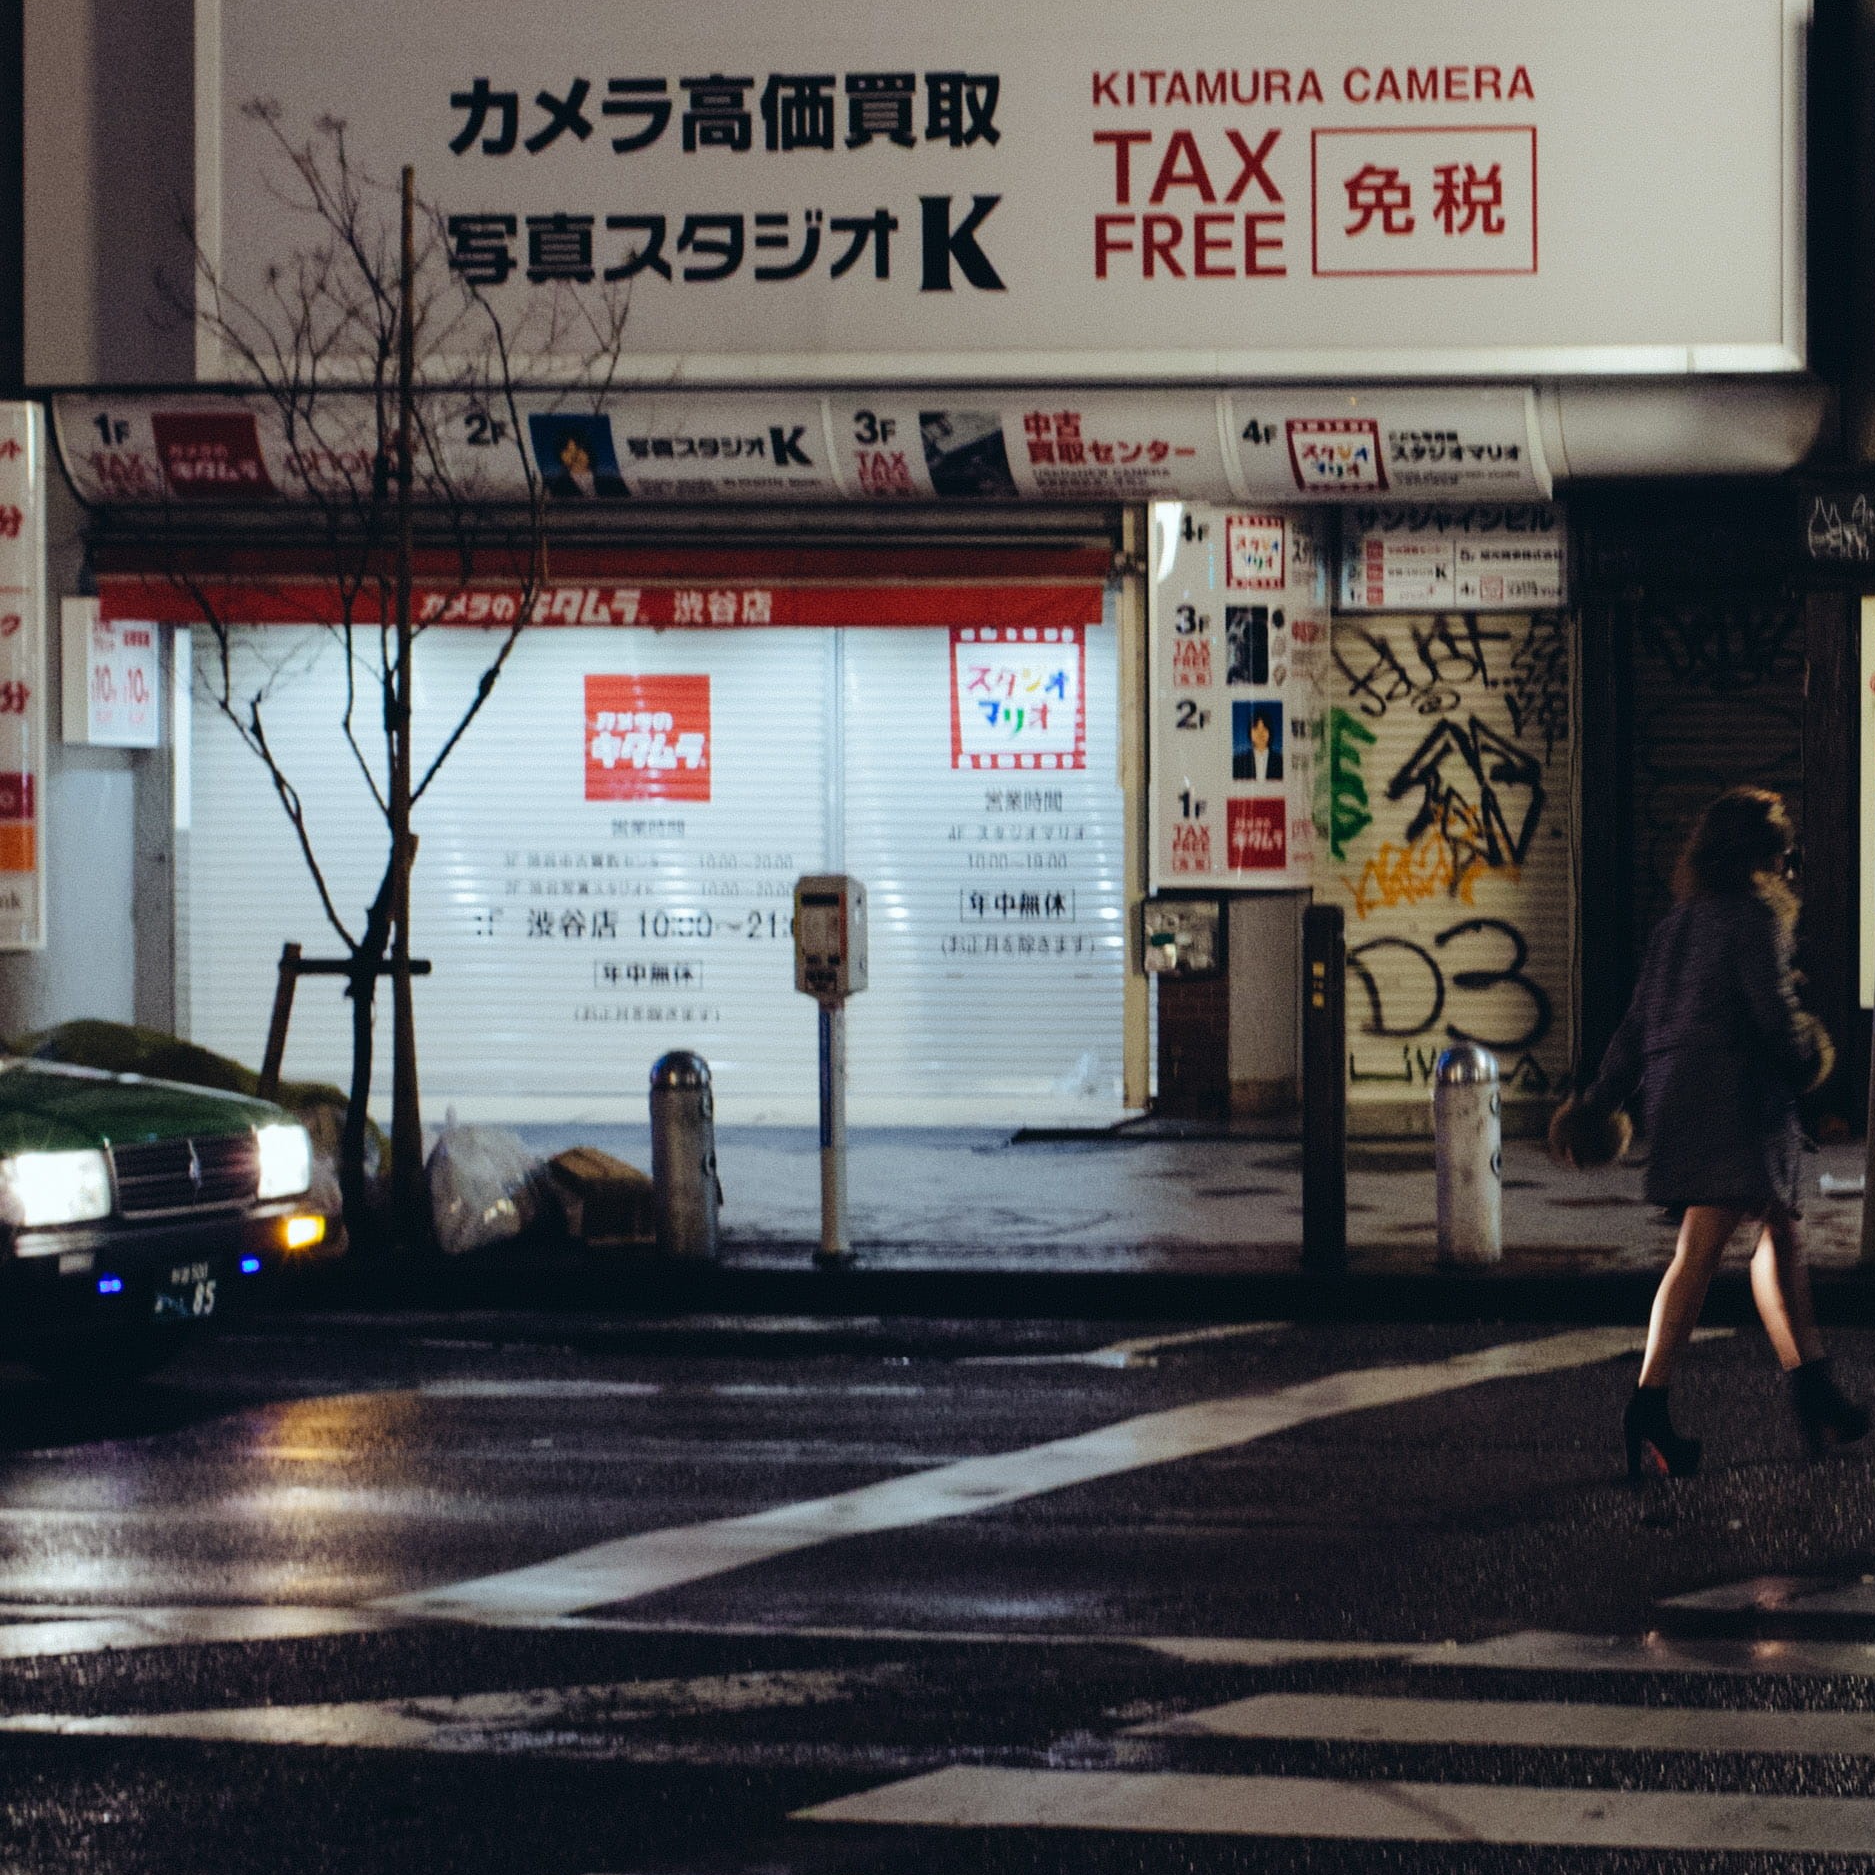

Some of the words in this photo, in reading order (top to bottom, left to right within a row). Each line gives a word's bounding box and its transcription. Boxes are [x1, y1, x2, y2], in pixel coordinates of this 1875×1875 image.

[1092, 68, 1324, 107] KITAMURA
[1343, 65, 1535, 104] CAMERA
[449, 72, 1001, 154] カメラ高価買取
[1093, 128, 1285, 205] TAX
[1343, 162, 1507, 237] 免税
[448, 194, 1009, 292] 写真スタジオK
[1095, 212, 1287, 280] FREE
[94, 412, 130, 445] 1F
[465, 414, 506, 446] 2F
[854, 410, 896, 444] 3F
[1024, 410, 1082, 439] 中古
[1242, 419, 1277, 445] 4F
[1028, 438, 1195, 465] 買取センター
[1391, 443, 1520, 462] スタジオマリオ
[419, 591, 515, 621] カメラの
[673, 588, 773, 625] 渋谷店
[1175, 604, 1210, 635] 3F
[1173, 639, 1211, 657] TAX
[968, 666, 1068, 700] スタジオ
[594, 711, 674, 732] カメラの
[977, 700, 1050, 739] マリオ
[1175, 698, 1212, 730] 2F
[590, 731, 705, 769] キタムラ
[984, 790, 1063, 813] 営業時間
[1178, 790, 1207, 820] 1F
[969, 891, 1066, 918] 年中無休
[527, 908, 618, 939] 渋谷店
[602, 963, 695, 986] 年中無休
